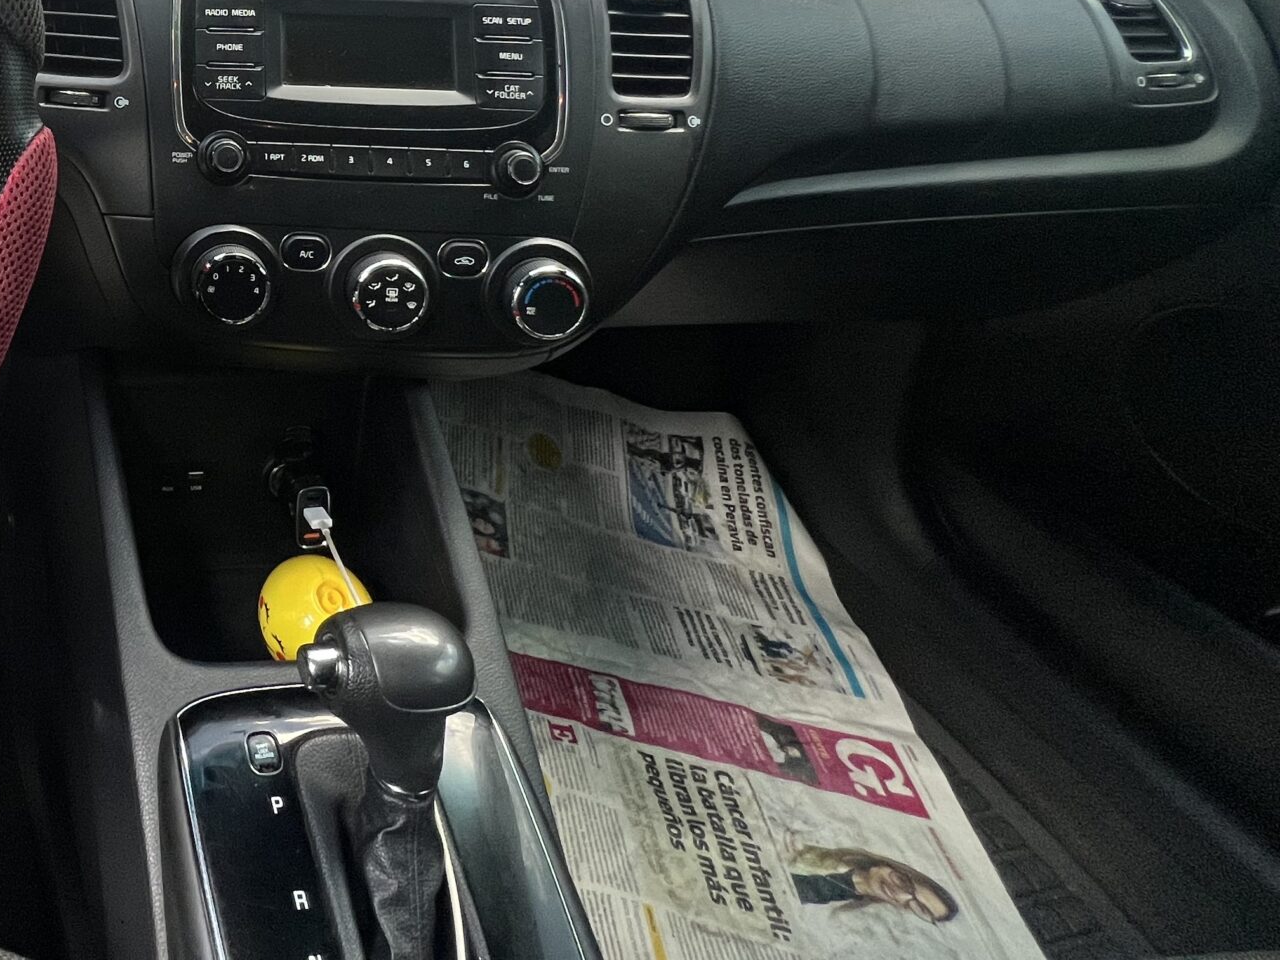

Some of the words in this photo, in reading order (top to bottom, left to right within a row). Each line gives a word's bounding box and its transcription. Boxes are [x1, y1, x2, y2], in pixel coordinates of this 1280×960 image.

[231, 9, 256, 17] MEDIA
[482, 16, 503, 25] SCAN
[506, 17, 532, 26] SETUP
[216, 43, 244, 51] PHONE
[499, 52, 523, 60] MENU
[215, 82, 242, 90] TRACK
[217, 75, 239, 83] SEEK
[494, 91, 526, 99] FOLDER
[504, 84, 520, 92] CAT
[301, 154, 306, 162] 2
[348, 156, 354, 164] 3
[386, 157, 393, 165] 4
[425, 158, 432, 167] 5
[463, 160, 470, 168] 6
[299, 250, 314, 259] A/C
[238, 265, 244, 273] 2
[729, 437, 742, 461] dos
[720, 485, 732, 501] en
[733, 462, 753, 528] toneladas
[744, 441, 764, 493] Agentes
[755, 494, 776, 558] confiscan
[723, 503, 743, 552] Peravia
[745, 528, 758, 546] de
[689, 763, 708, 785] la
[664, 757, 698, 817] libran
[270, 796, 284, 815] P
[637, 749, 687, 853] pequeños
[697, 787, 738, 864] batalla
[686, 818, 710, 853] los
[713, 769, 755, 841] Cáncer
[740, 840, 793, 942] infantil:
[697, 853, 730, 907] más
[723, 864, 754, 913] que
[292, 890, 309, 911] R
